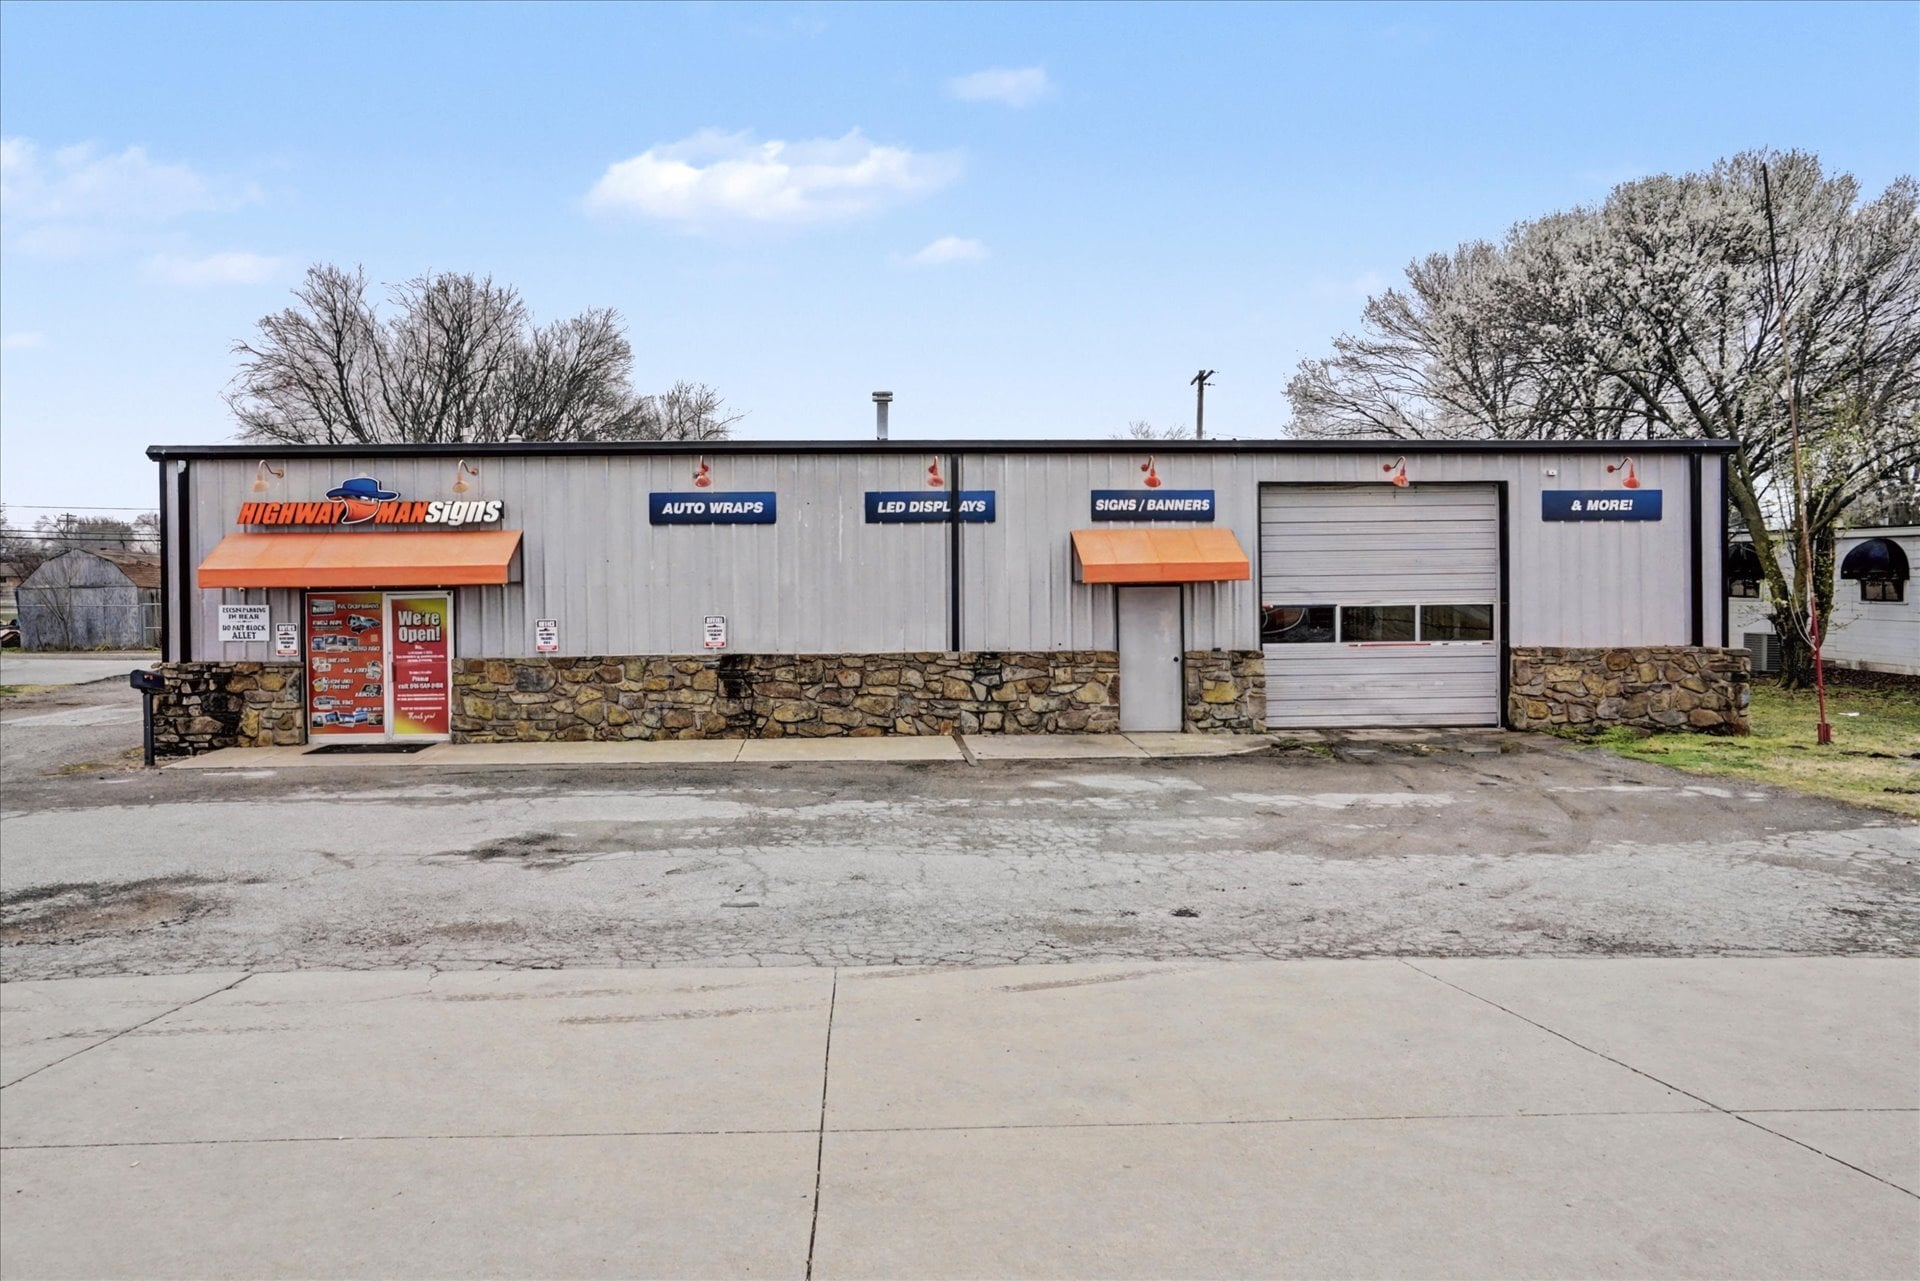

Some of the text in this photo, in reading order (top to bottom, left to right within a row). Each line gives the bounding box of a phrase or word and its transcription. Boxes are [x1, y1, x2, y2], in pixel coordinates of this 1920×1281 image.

[662, 501, 764, 514] AUTO WRAPS
[877, 500, 986, 513] LED DISPLAYS
[1095, 499, 1137, 511] SIGNS
[1146, 499, 1210, 511] BANNERS
[1571, 499, 1633, 511] & MORE!
[237, 501, 345, 525] HIGHWAY
[398, 610, 440, 626] We're
[232, 632, 256, 640] ALLEY
[398, 626, 441, 642] Open!
